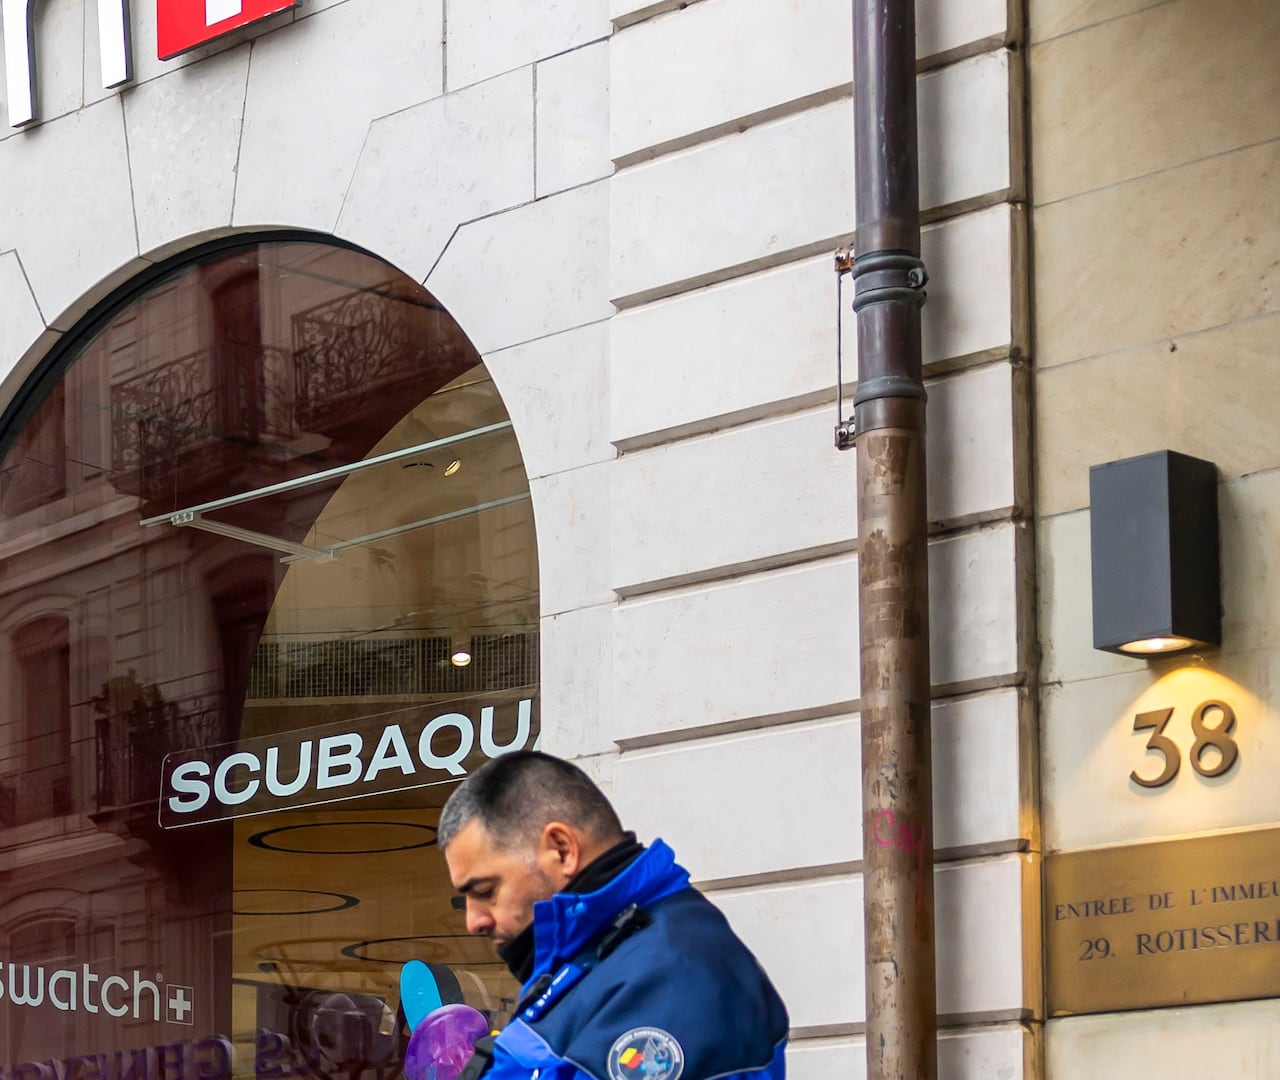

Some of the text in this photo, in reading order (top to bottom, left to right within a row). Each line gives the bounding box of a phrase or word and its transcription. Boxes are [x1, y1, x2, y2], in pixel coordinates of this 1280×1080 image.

[167, 698, 541, 814] SCUBAQU
[1129, 698, 1240, 789] 38
[1054, 895, 1135, 921] ENTREE
[1148, 891, 1176, 911] DE
